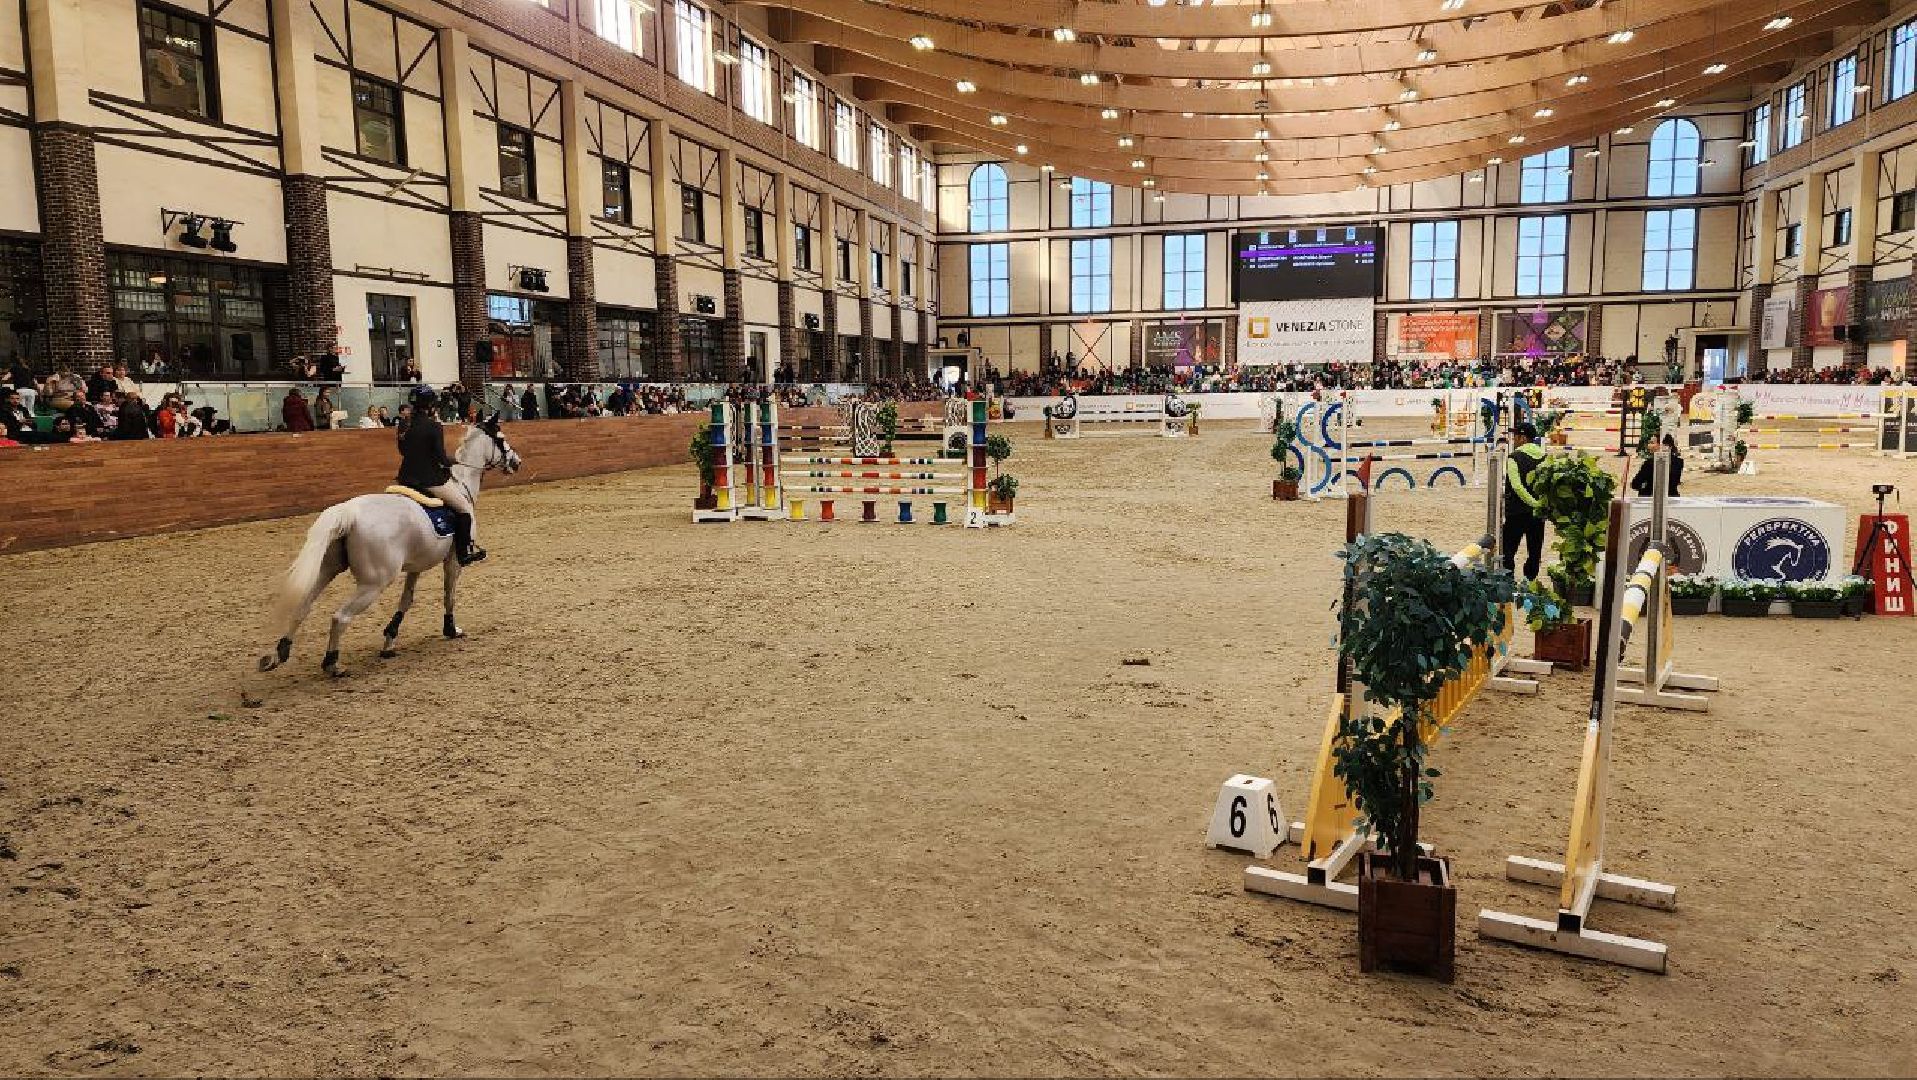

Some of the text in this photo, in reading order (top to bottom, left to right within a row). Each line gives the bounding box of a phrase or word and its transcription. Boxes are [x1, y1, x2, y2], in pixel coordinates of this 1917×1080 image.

[1276, 319, 1365, 333] VENEZIA STONE
[970, 511, 977, 525] 2
[1743, 521, 1821, 547] PERSPEKTIVA
[1881, 520, 1904, 612] ФИНИШ
[1230, 795, 1247, 838] 6
[1267, 792, 1278, 835] 6
